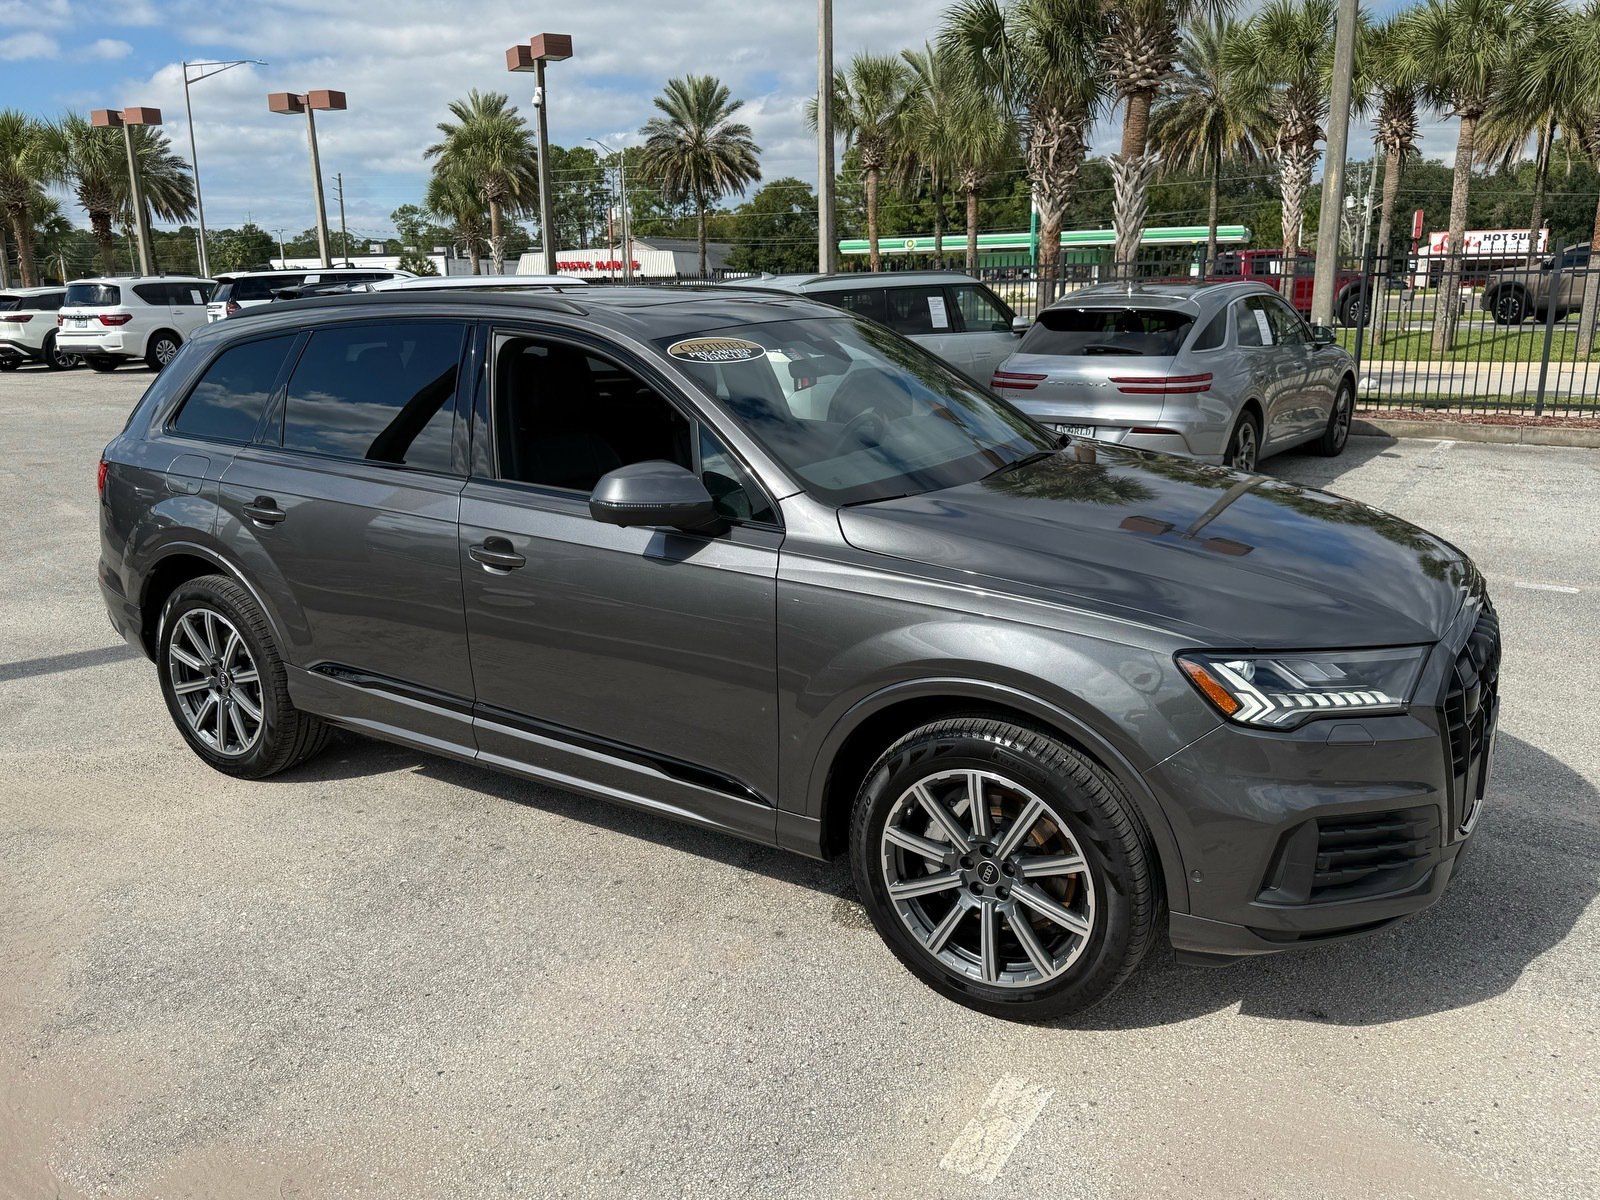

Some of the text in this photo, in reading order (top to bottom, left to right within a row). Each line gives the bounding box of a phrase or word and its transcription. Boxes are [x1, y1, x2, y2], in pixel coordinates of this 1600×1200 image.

[1483, 232, 1543, 241] HOT SUS
[680, 342, 747, 352] CERTIFIED
[688, 348, 752, 358] PRE-OWNED
[701, 353, 750, 361] VEHICLES
